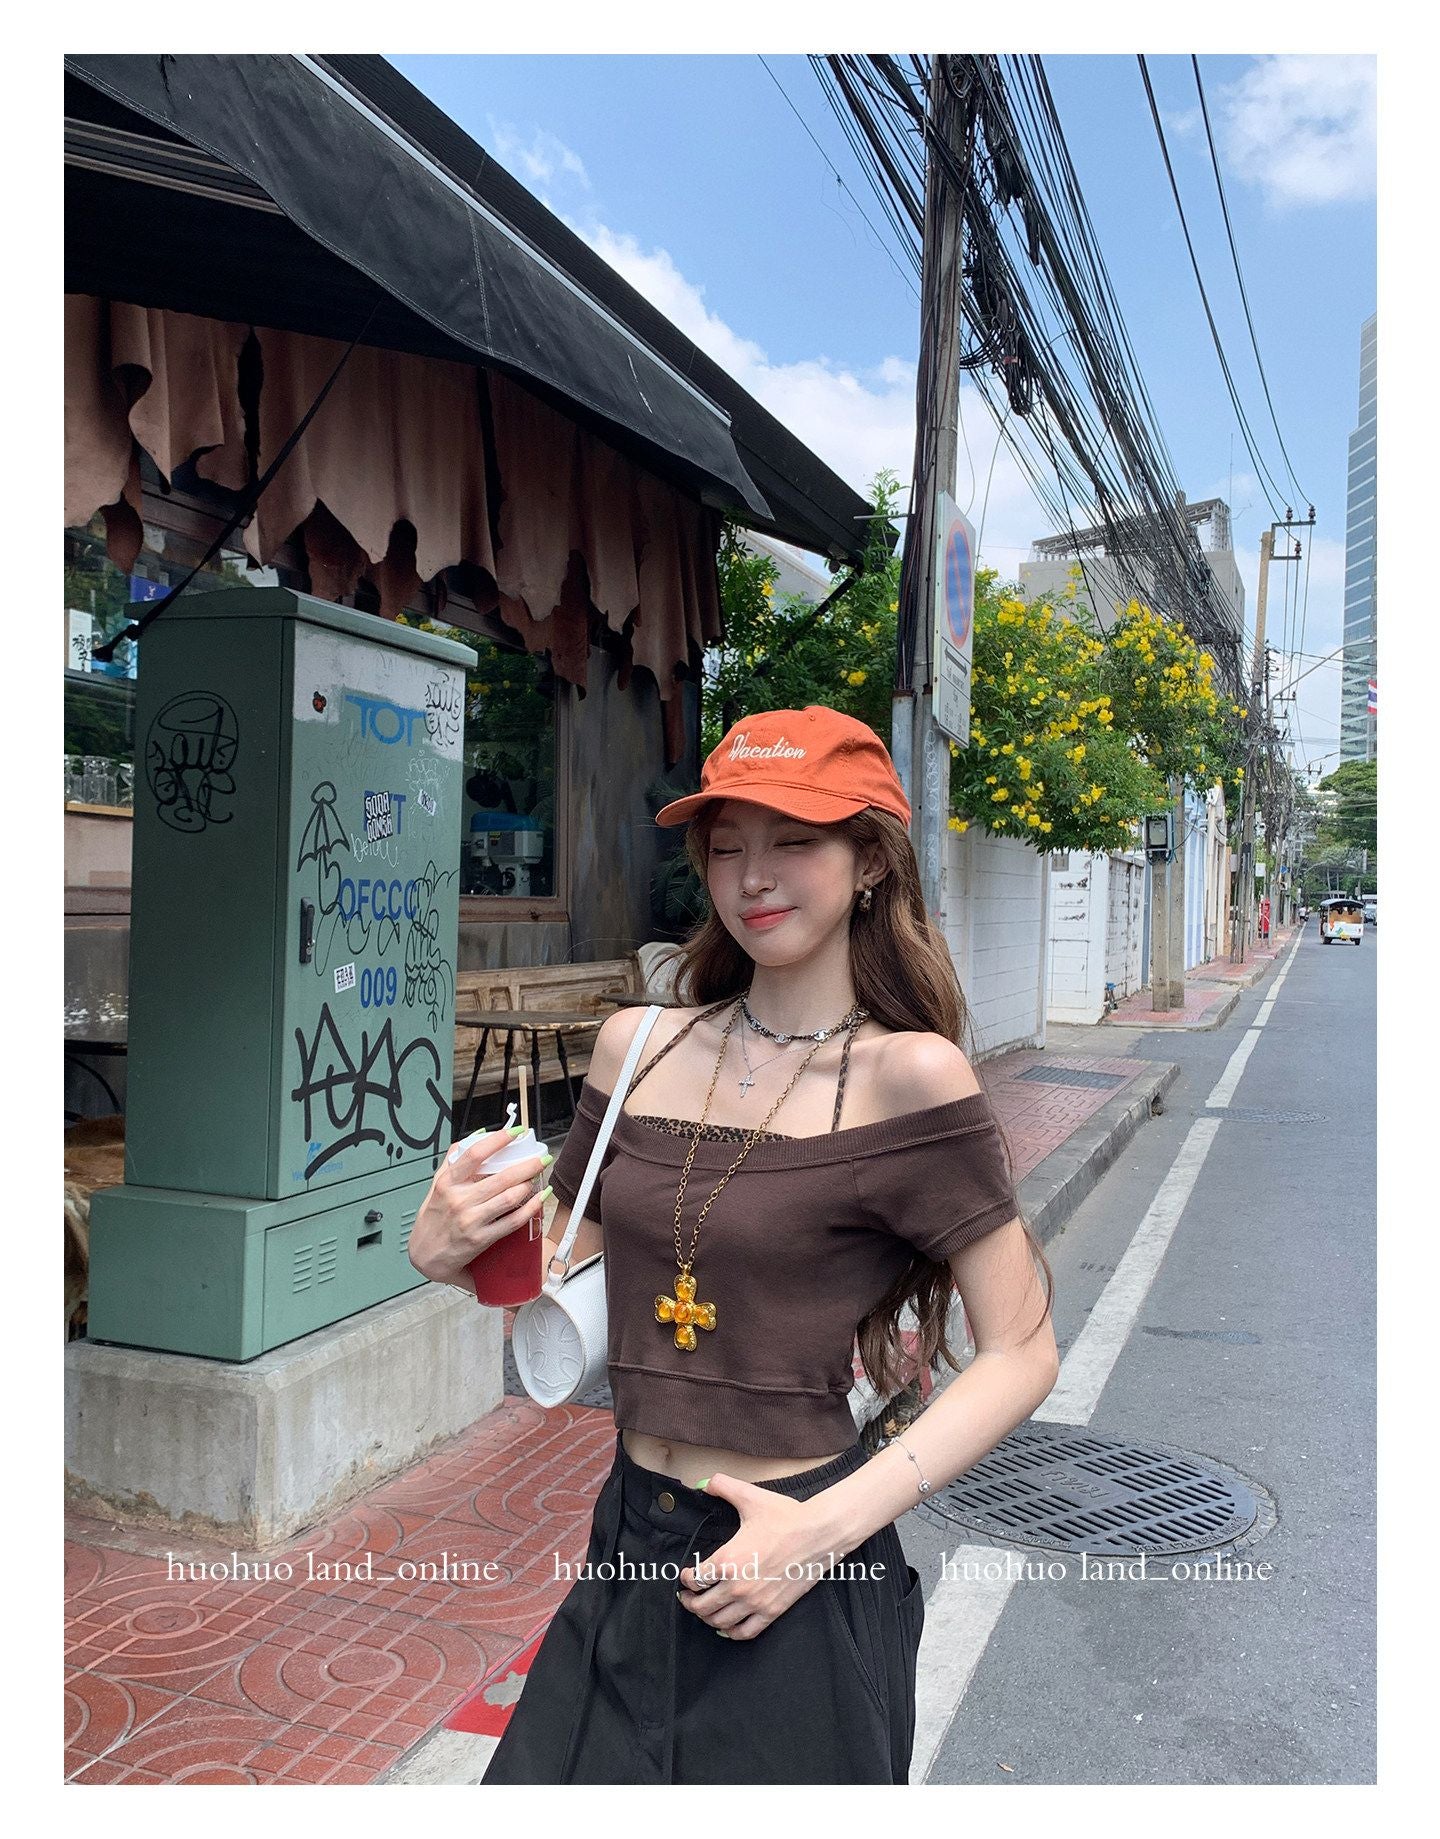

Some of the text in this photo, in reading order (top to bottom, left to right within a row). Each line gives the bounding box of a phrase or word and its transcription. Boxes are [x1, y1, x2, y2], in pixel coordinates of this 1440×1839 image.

[344, 694, 428, 746] TOT
[728, 731, 807, 761] Vacation
[360, 966, 398, 1009] 009
